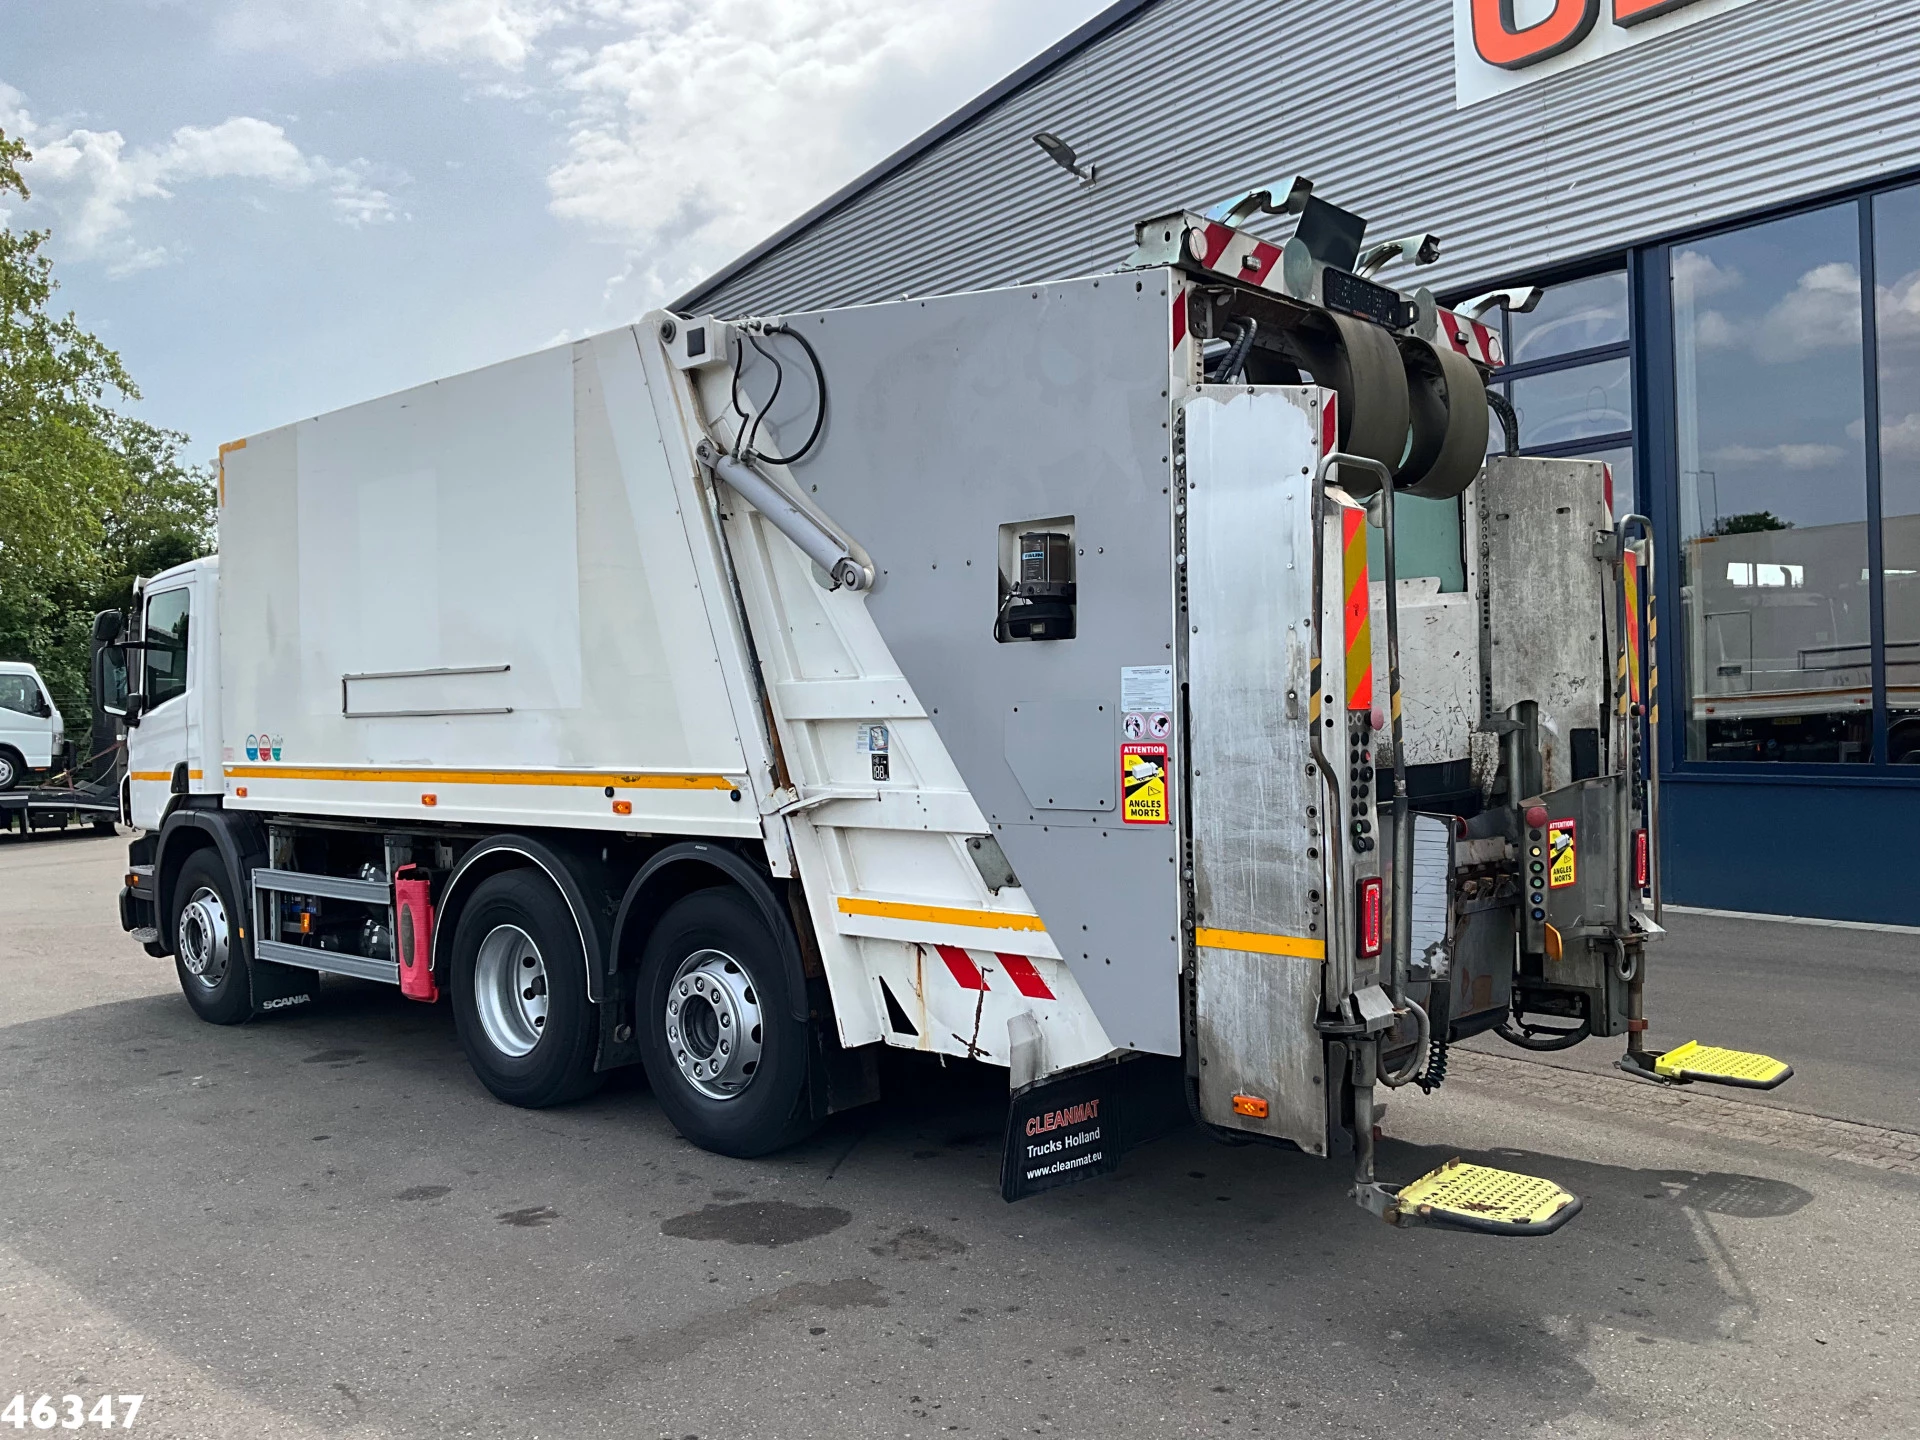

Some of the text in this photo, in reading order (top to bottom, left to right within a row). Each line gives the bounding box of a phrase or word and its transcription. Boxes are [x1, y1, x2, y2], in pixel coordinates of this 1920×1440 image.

[1123, 745, 1165, 754] ATTENTION
[1128, 799, 1161, 809] ANGLES
[1130, 808, 1160, 818] MORTS
[1549, 820, 1574, 830] ATTENTION
[1553, 865, 1572, 876] ANGLES
[1554, 873, 1572, 883] MORTS
[263, 993, 311, 1010] SCANIA
[1025, 1099, 1100, 1137] CLEANMAT
[1026, 1127, 1101, 1159] Trucks Holland
[1026, 1151, 1102, 1180] www.cleanmat.eu
